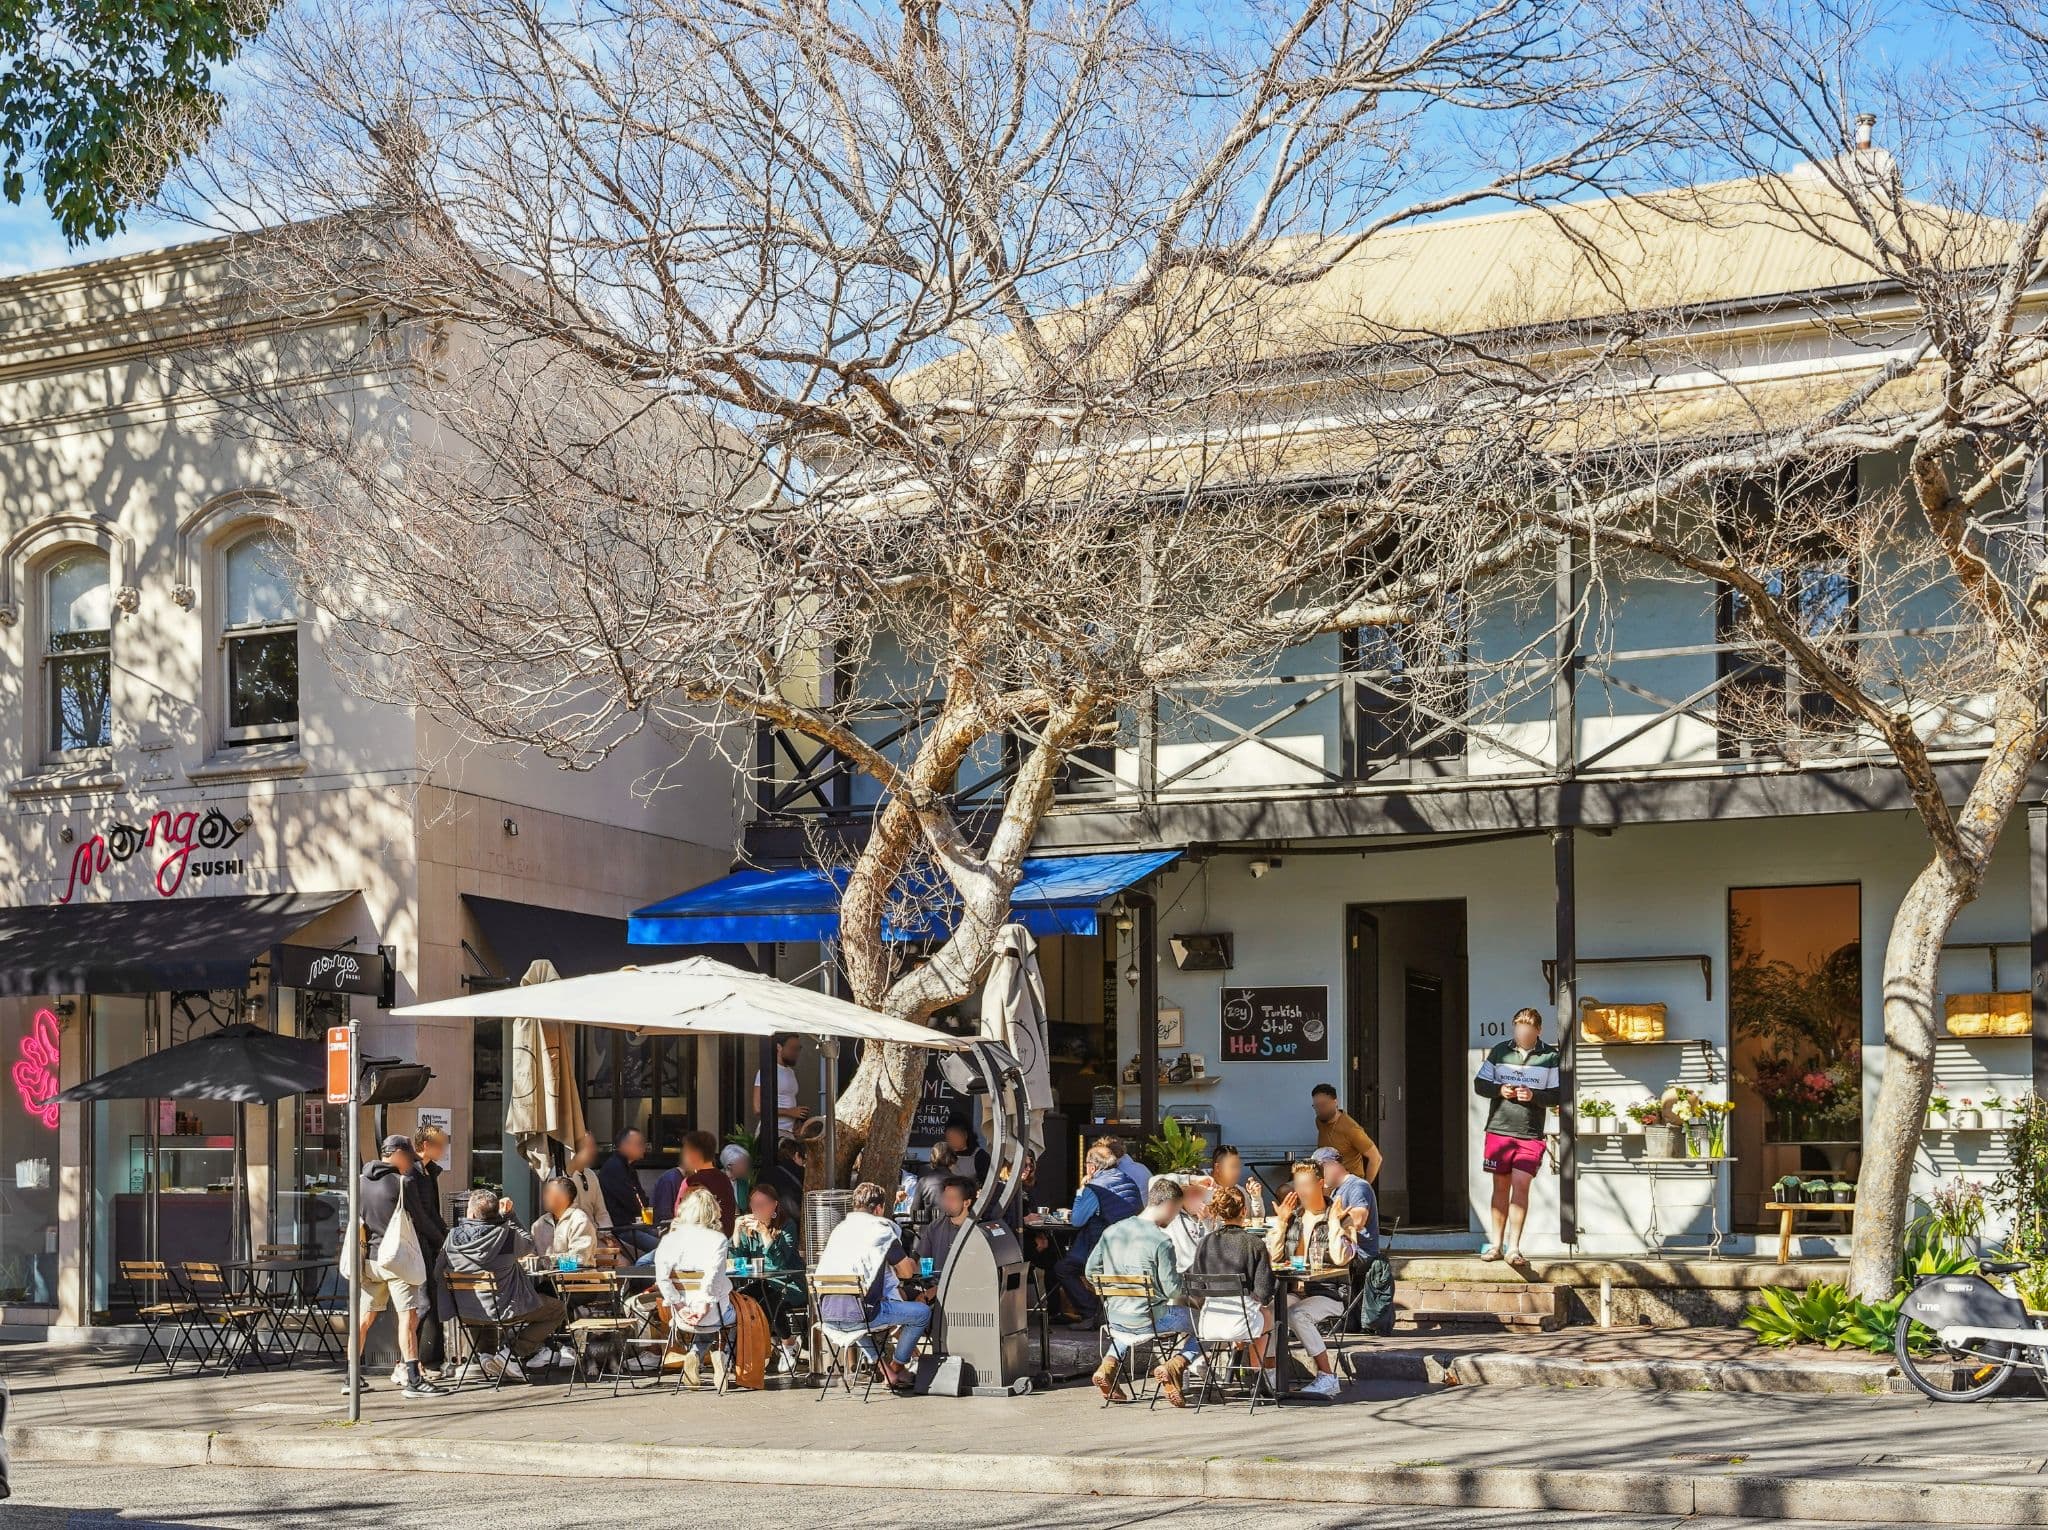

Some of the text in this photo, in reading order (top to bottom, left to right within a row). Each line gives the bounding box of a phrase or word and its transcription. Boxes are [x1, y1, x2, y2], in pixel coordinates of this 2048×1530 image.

[191, 859, 244, 877] SUSHI
[1261, 1005, 1302, 1018] Turkish
[1260, 1019, 1293, 1035] Style
[1480, 1022, 1505, 1036] 101
[1230, 1035, 1298, 1055] Hot Soup
[925, 1105, 950, 1114] FETA
